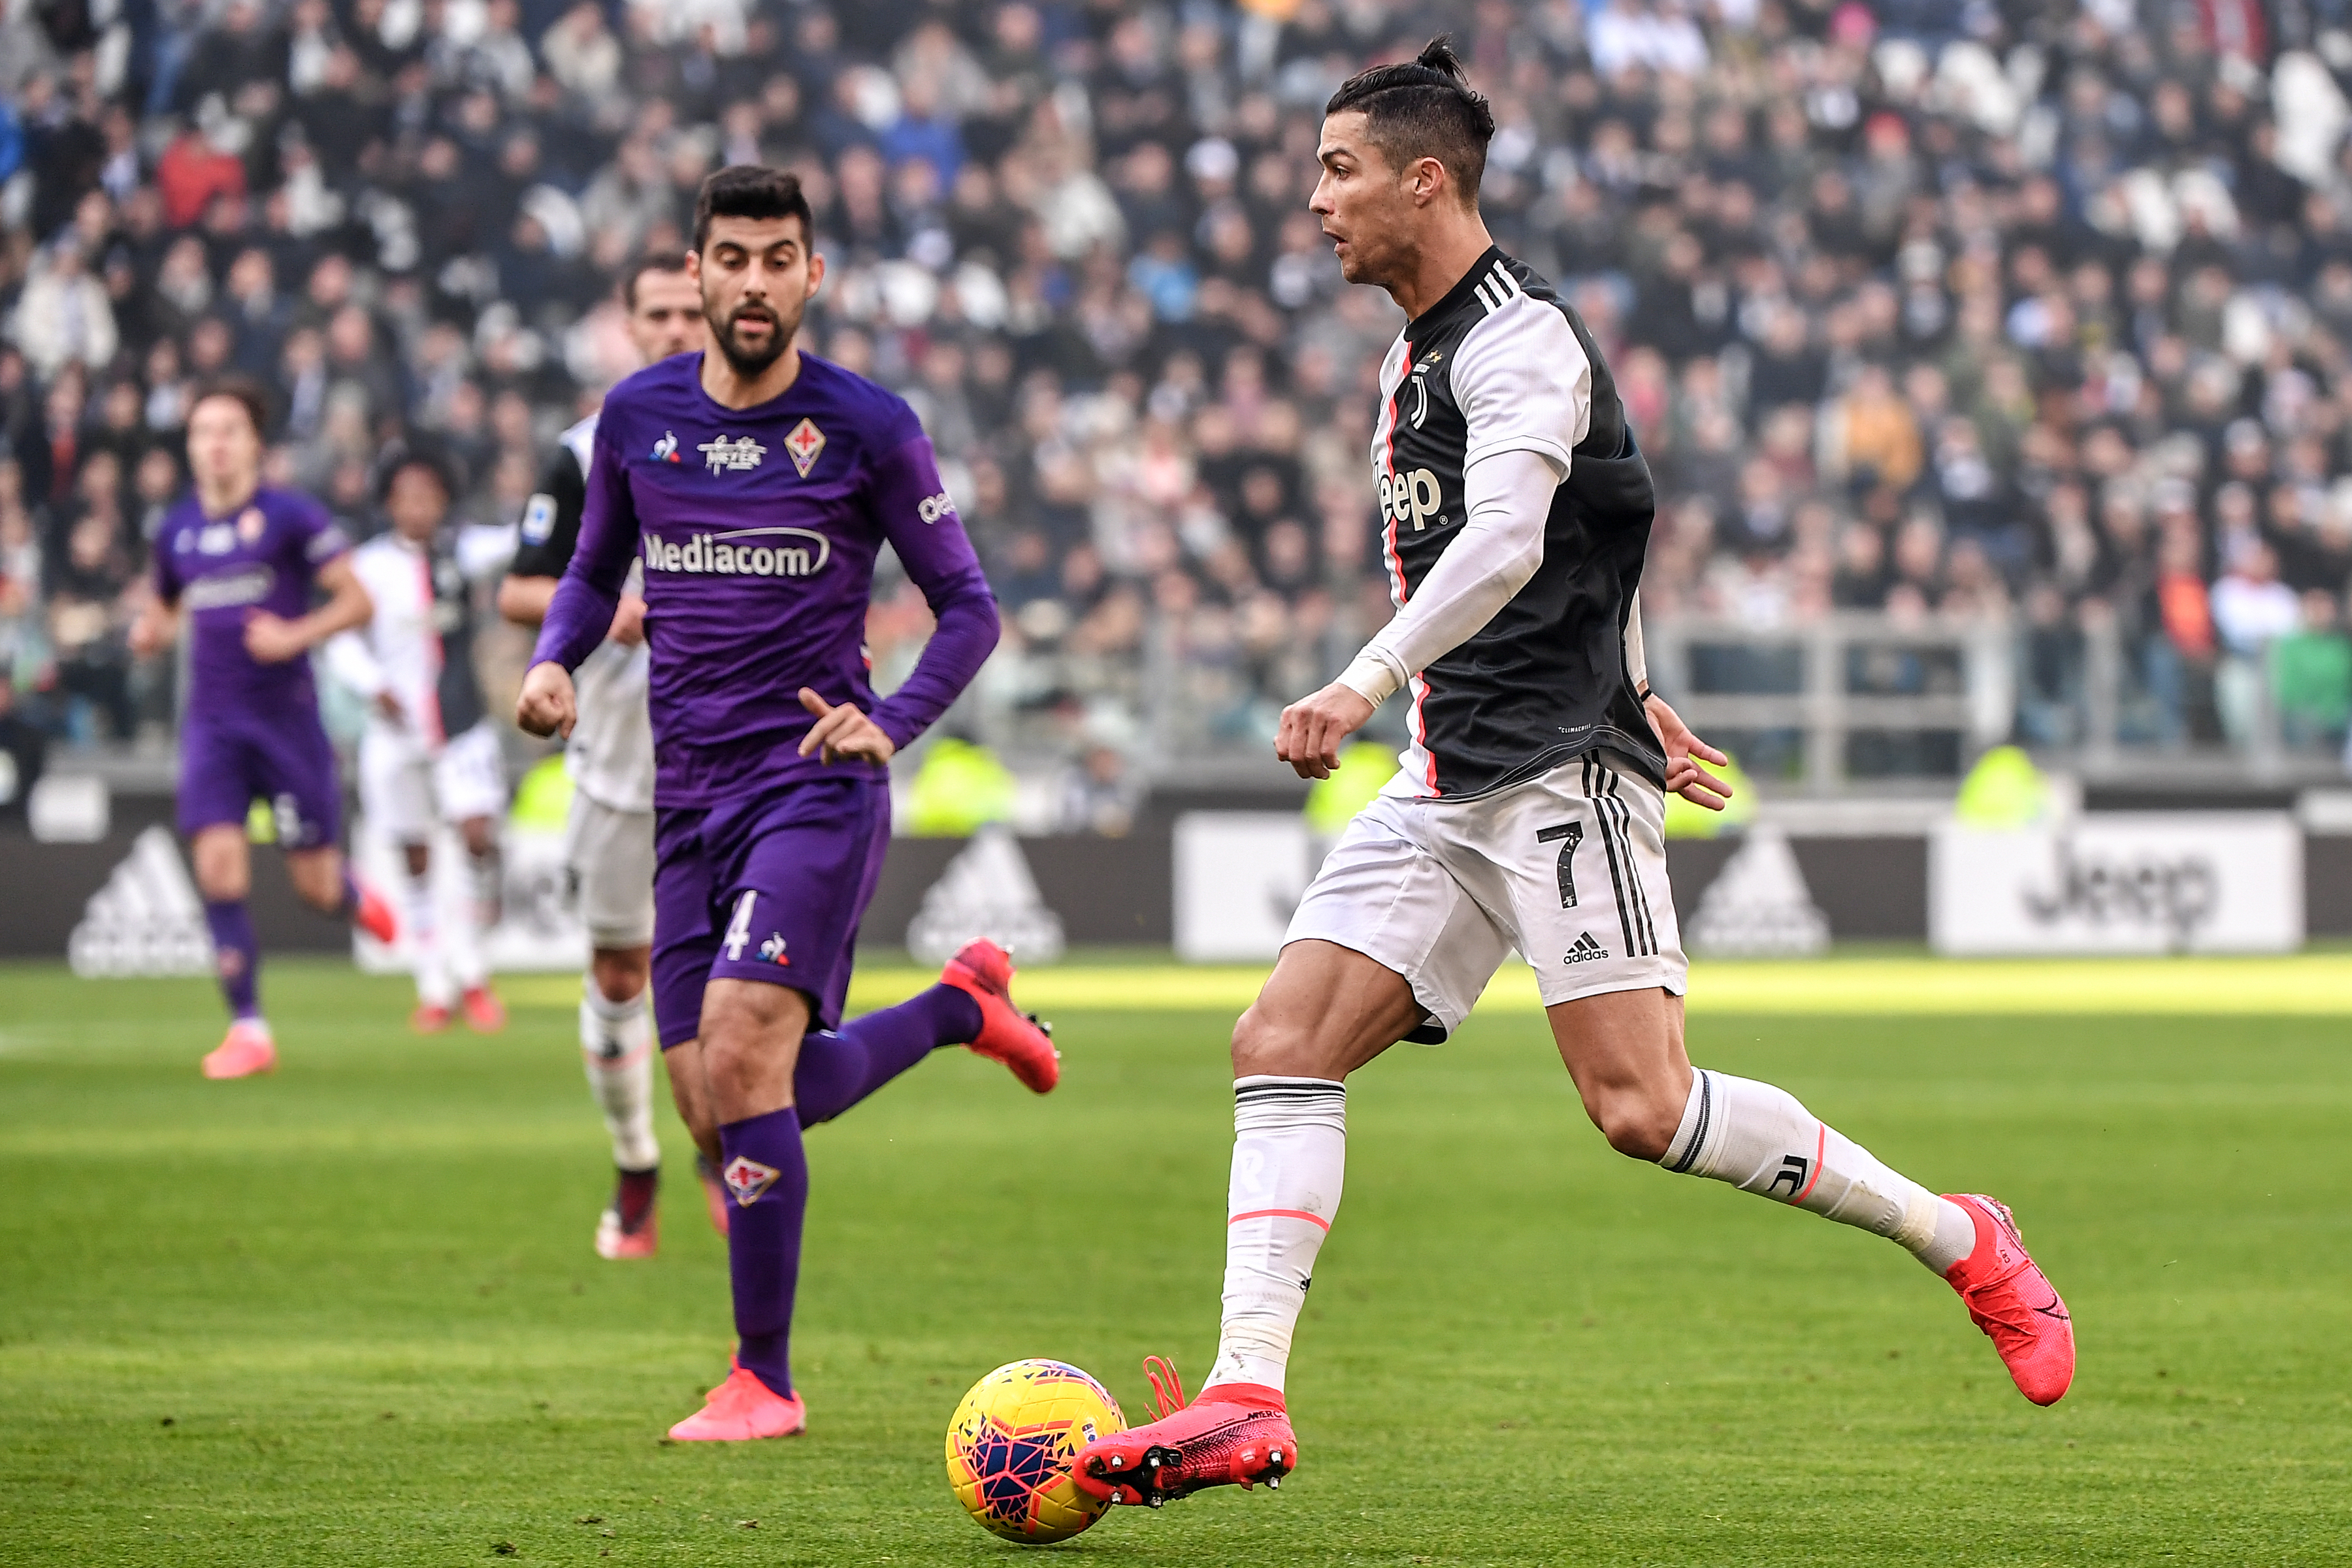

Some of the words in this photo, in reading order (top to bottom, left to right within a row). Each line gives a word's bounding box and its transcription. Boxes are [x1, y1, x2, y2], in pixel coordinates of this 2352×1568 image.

[644, 532, 811, 576] Mediacom
[1536, 821, 1583, 909] 7
[723, 889, 758, 961] 4
[1563, 949, 1609, 965] adidas
